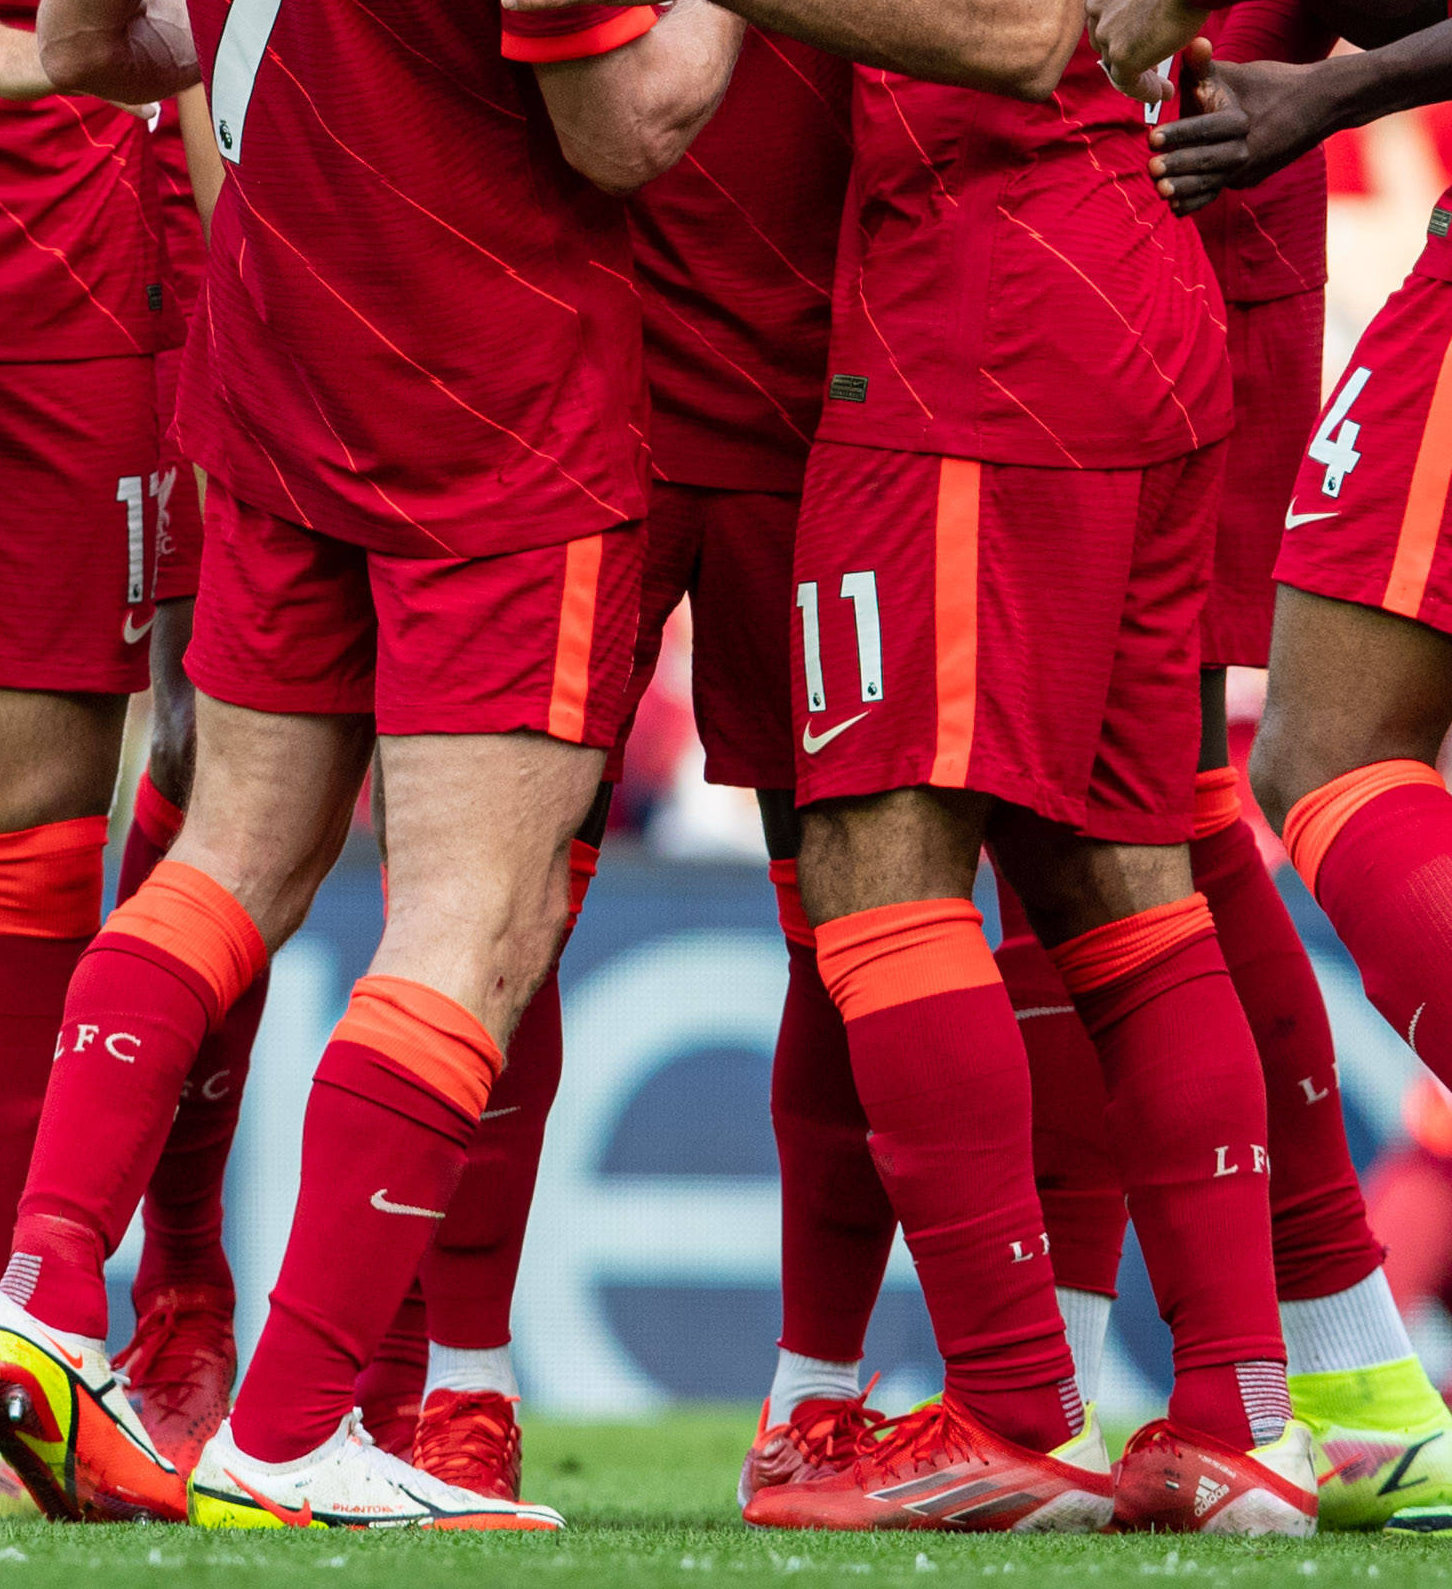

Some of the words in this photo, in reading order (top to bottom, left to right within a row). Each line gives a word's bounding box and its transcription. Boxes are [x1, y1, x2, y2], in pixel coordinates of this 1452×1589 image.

[1307, 366, 1372, 498] 4
[796, 570, 884, 713] 11
[1194, 1484, 1230, 1517] adidas
